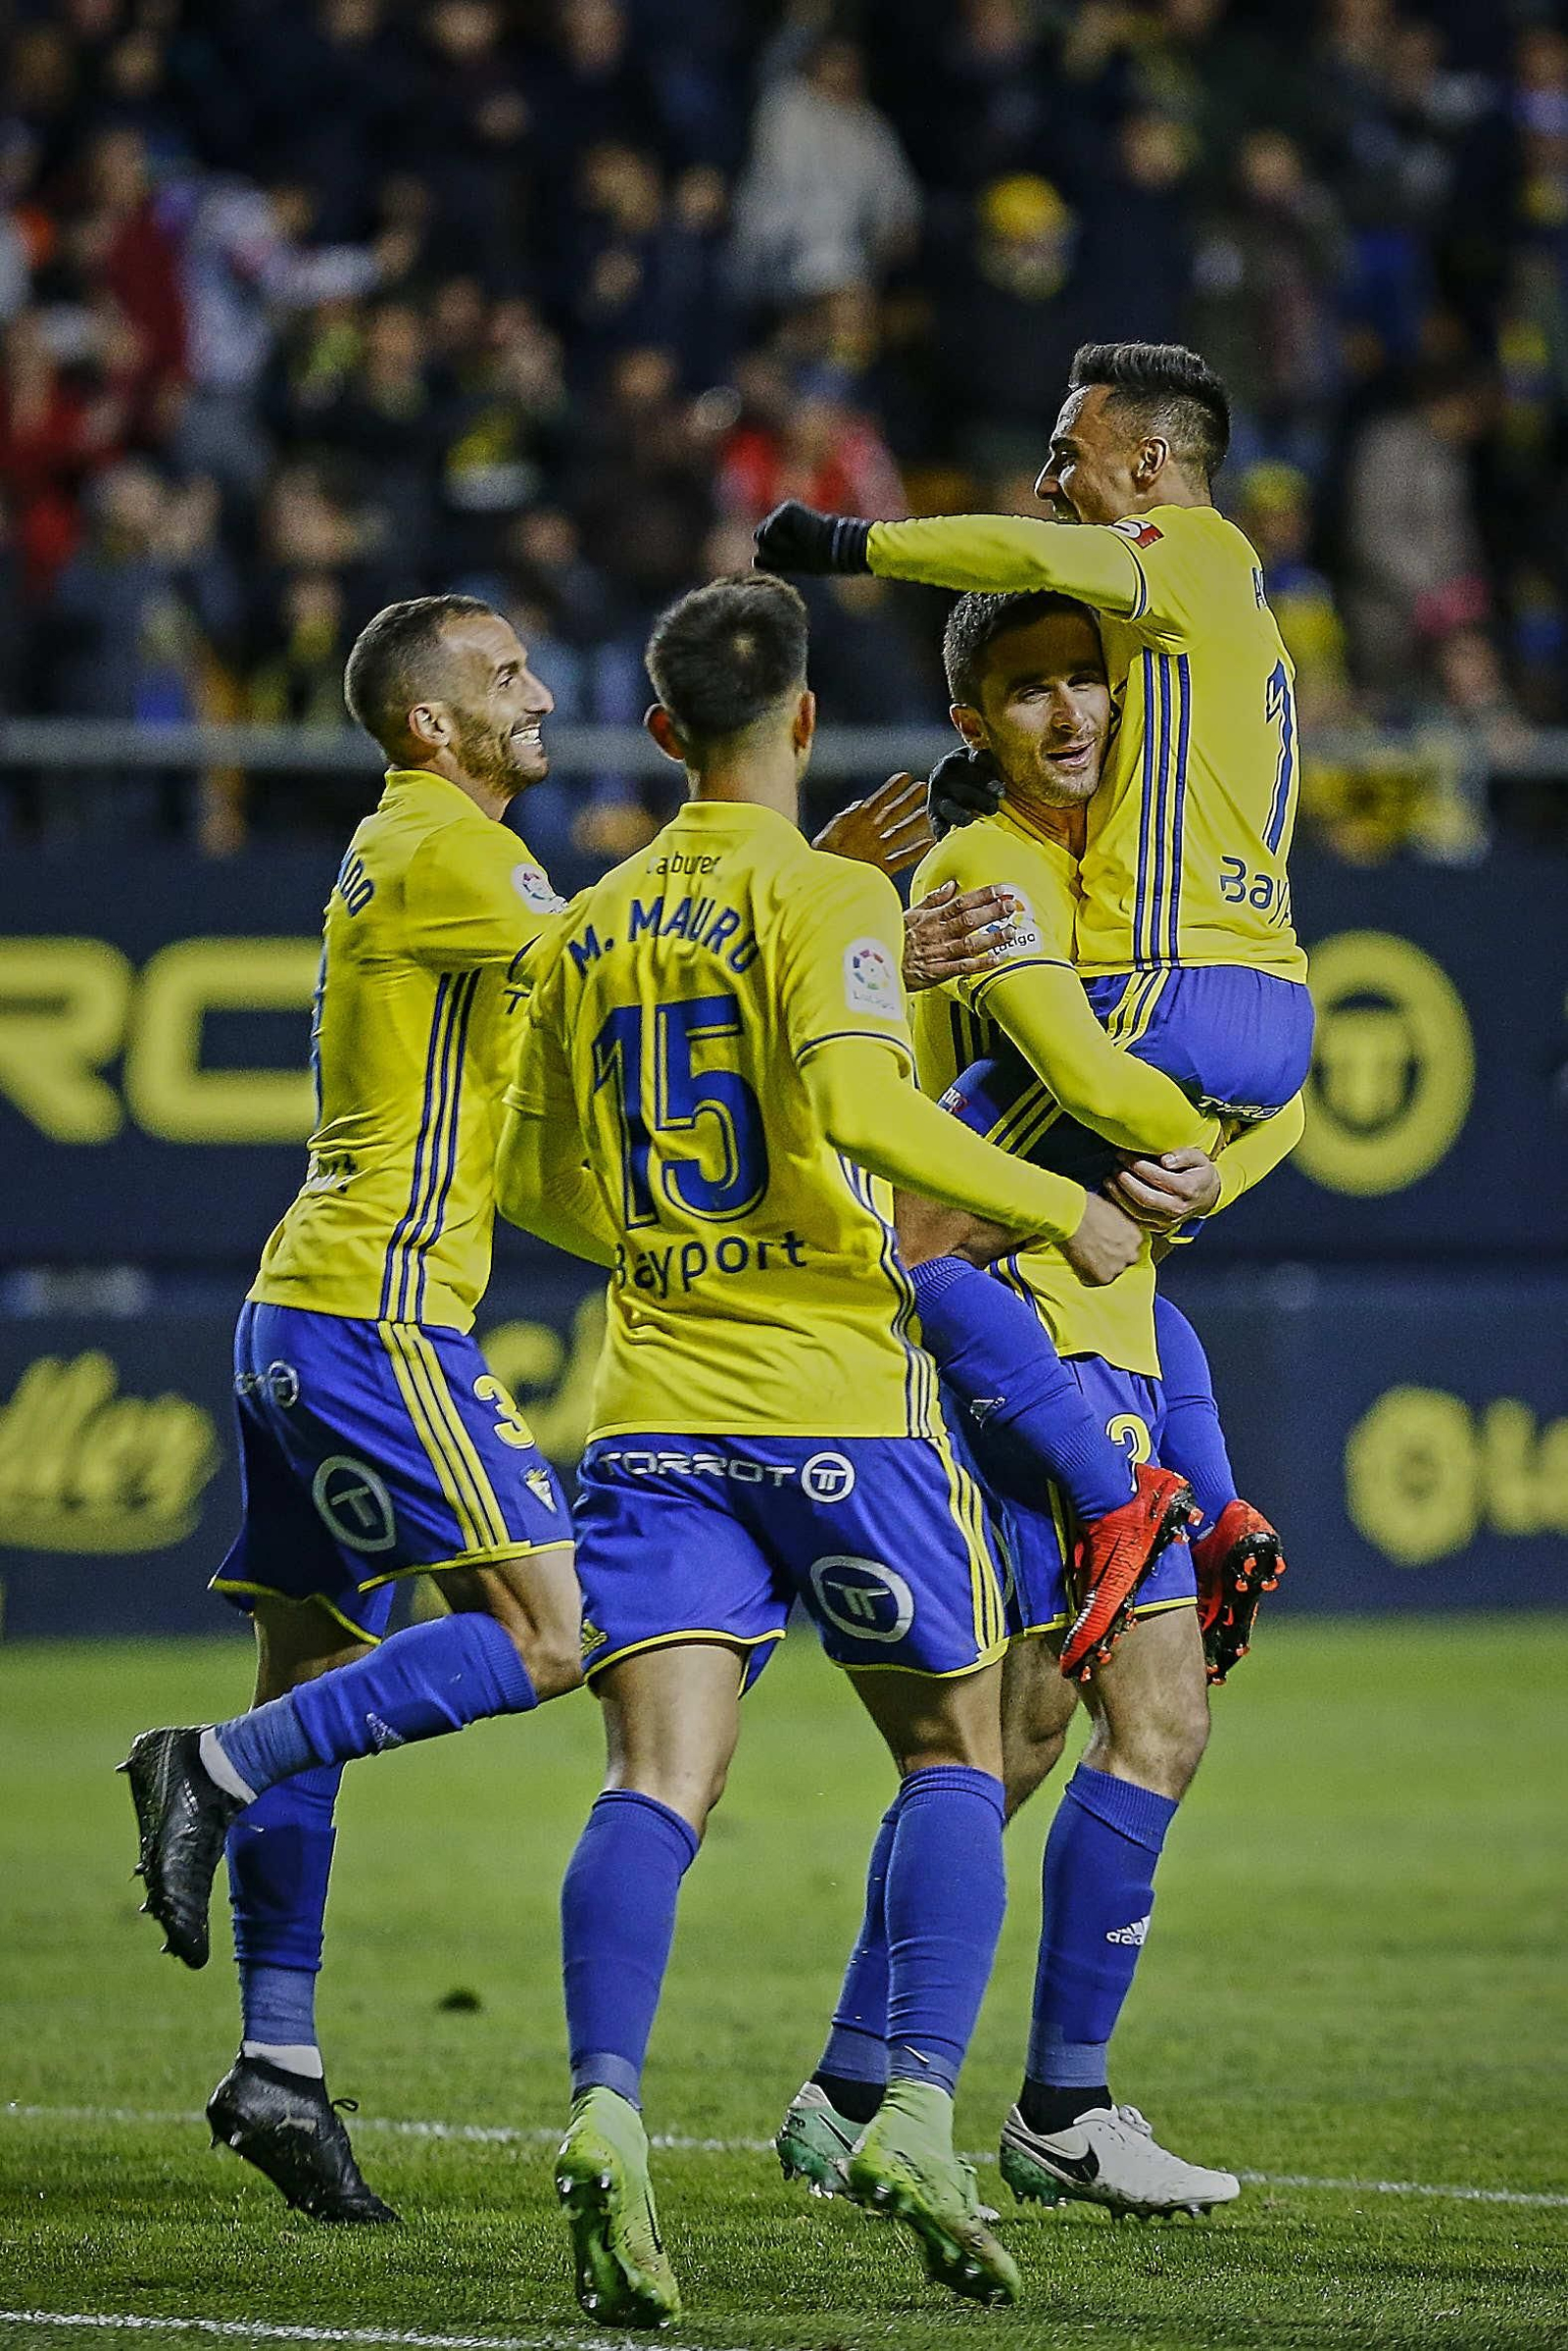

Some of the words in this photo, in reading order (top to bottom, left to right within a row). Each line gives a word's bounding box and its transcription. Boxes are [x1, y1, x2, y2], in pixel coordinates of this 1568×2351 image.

[568, 924, 614, 979] M.
[591, 993, 770, 1231] 15
[473, 1374, 535, 1449] 3
[598, 1452, 797, 1488] TORROT
